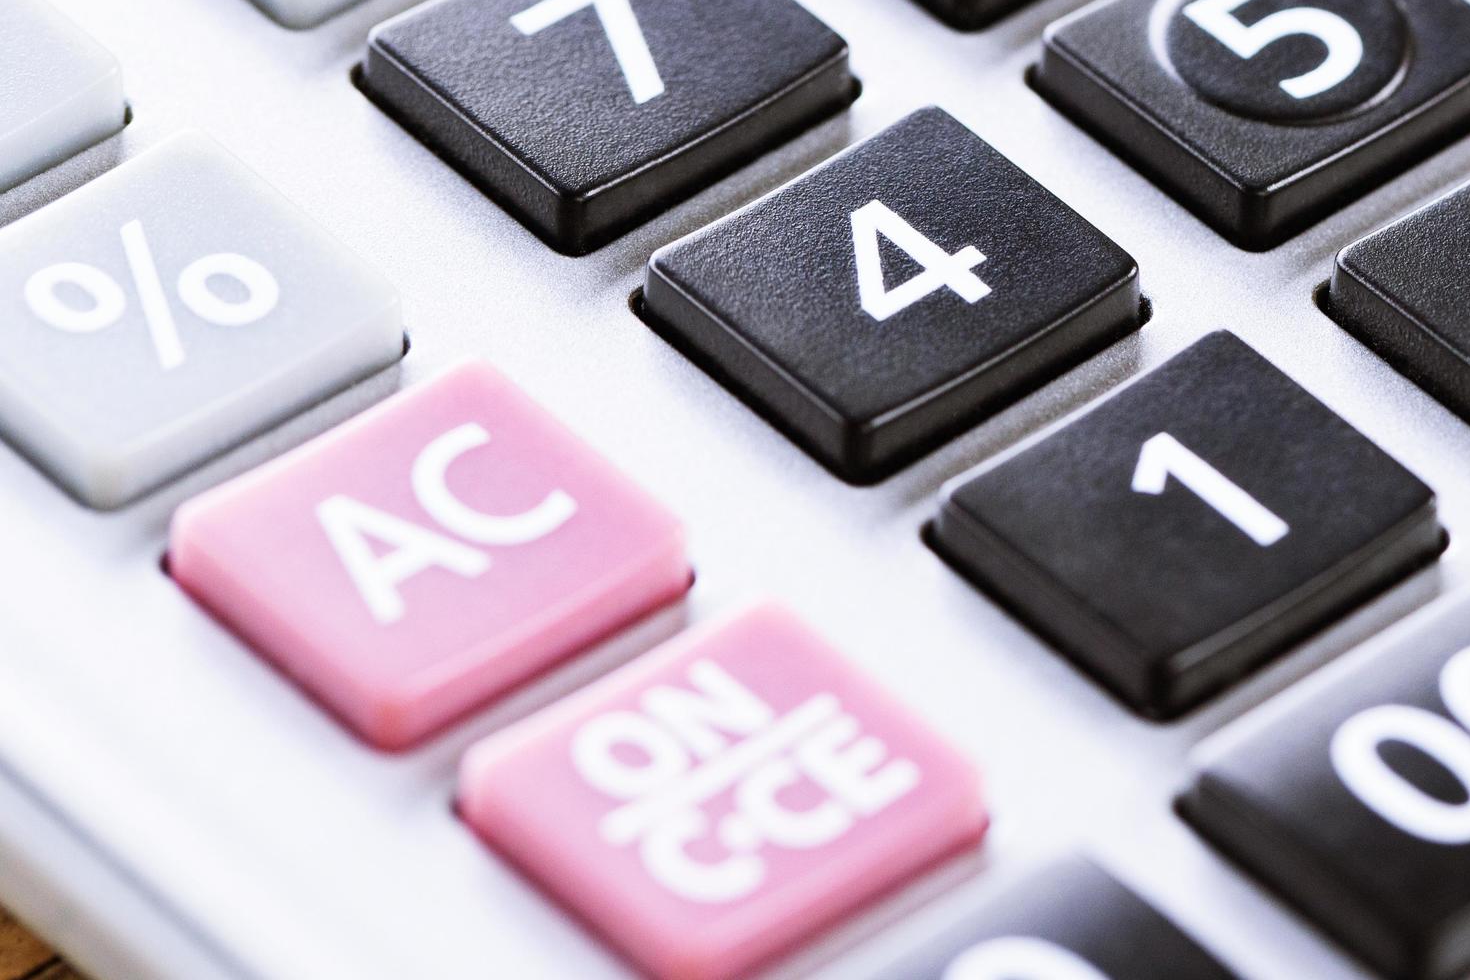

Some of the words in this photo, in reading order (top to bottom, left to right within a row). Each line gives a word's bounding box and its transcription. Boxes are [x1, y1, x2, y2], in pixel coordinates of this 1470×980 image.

[23, 219, 281, 372] %
[849, 198, 993, 322] 4
[314, 422, 579, 625] AC
[1131, 431, 1290, 547] 1
[570, 657, 778, 802] ON
